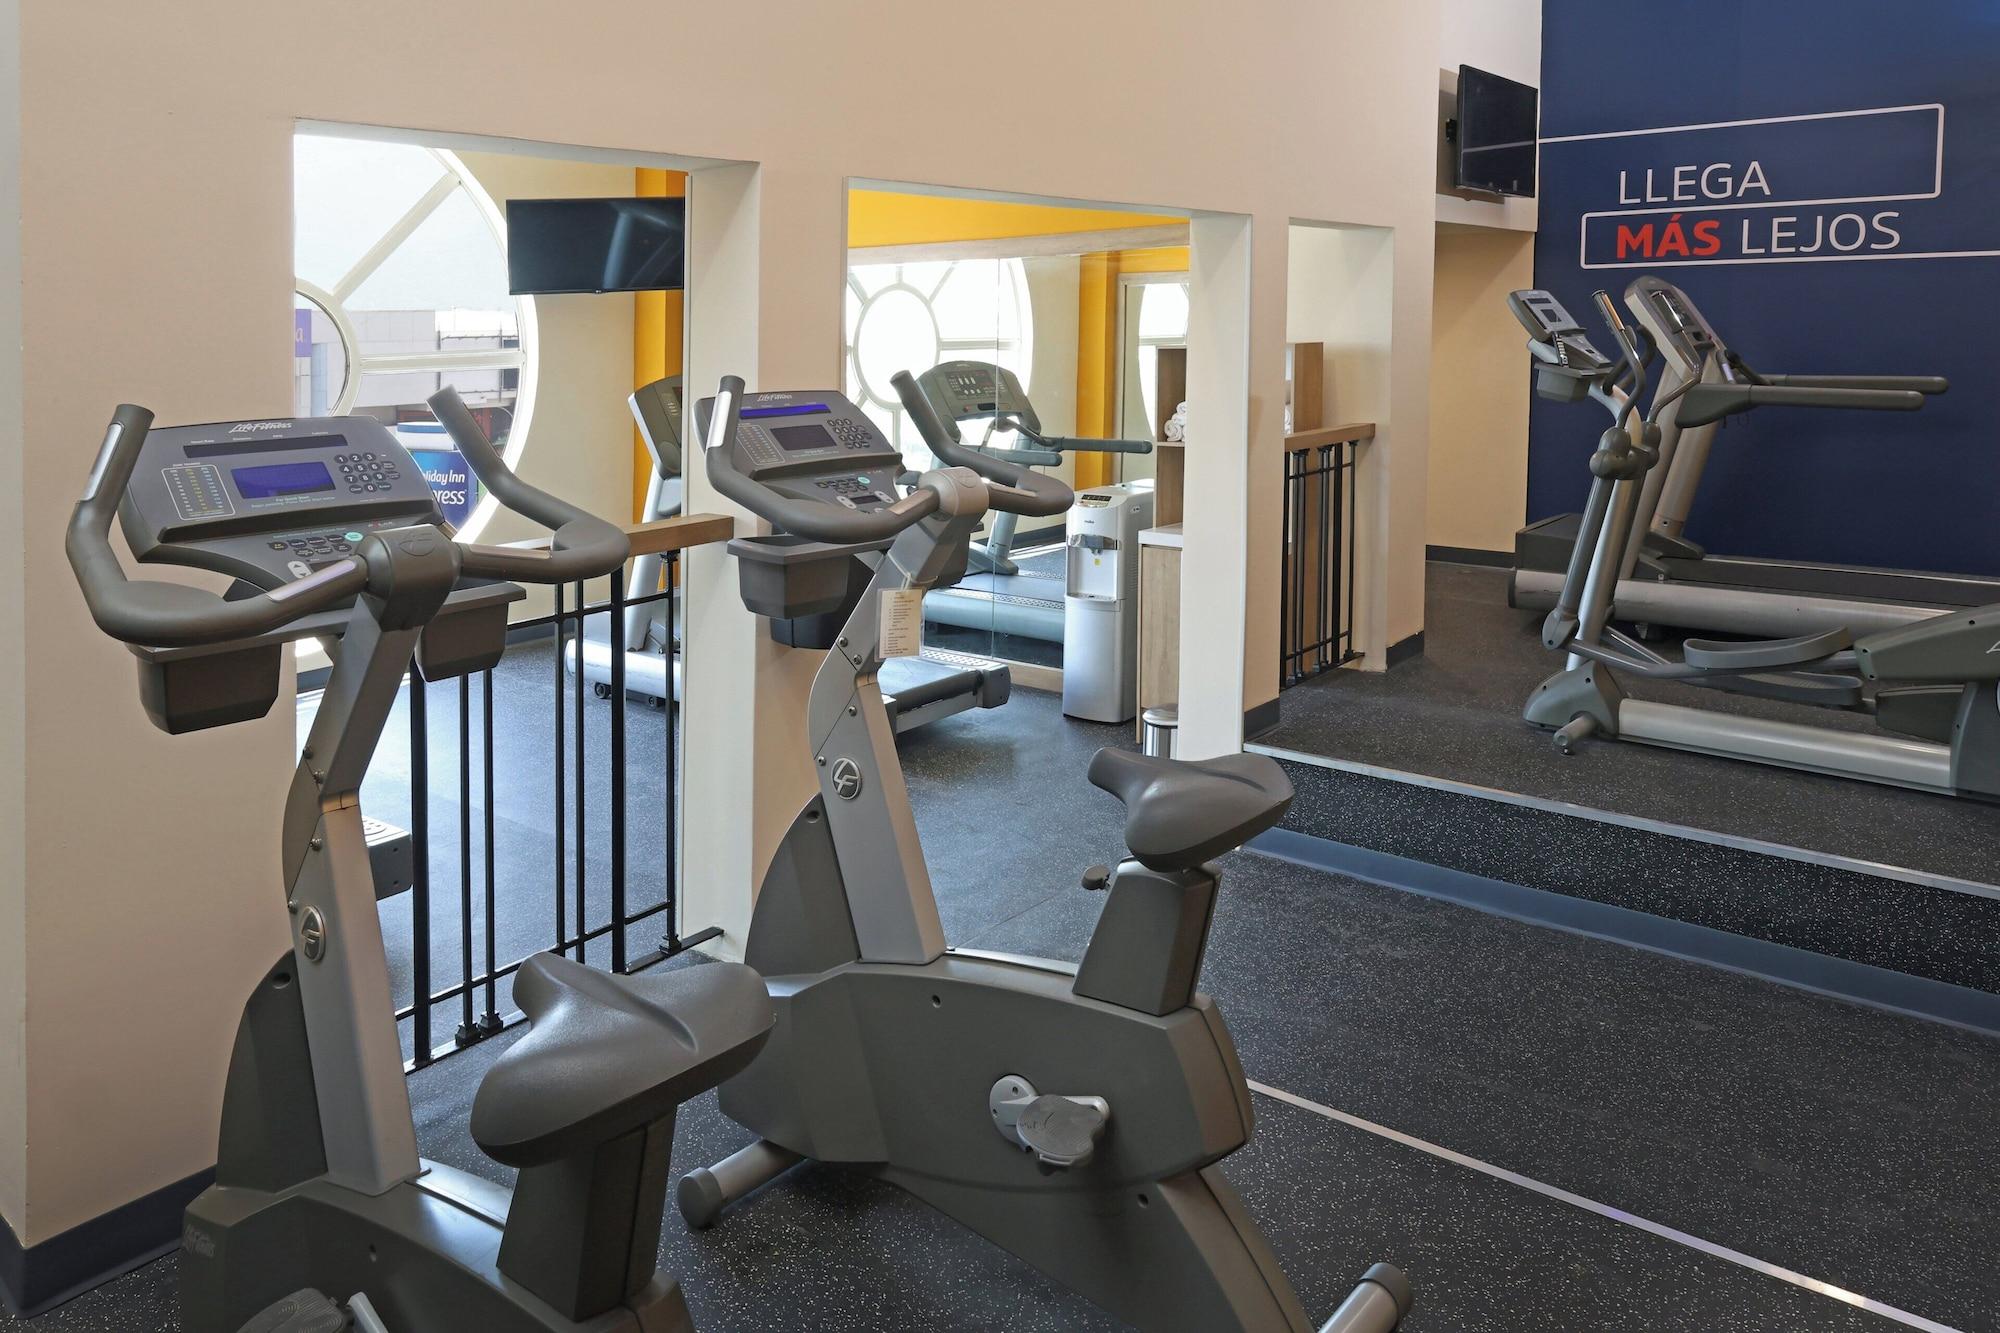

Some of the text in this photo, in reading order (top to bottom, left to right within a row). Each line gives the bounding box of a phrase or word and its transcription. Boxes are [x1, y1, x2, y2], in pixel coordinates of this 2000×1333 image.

[1619, 160, 1771, 204] LLEGA
[1616, 211, 1901, 259] MÁS LEJOS
[424, 469, 466, 486] liday Inn
